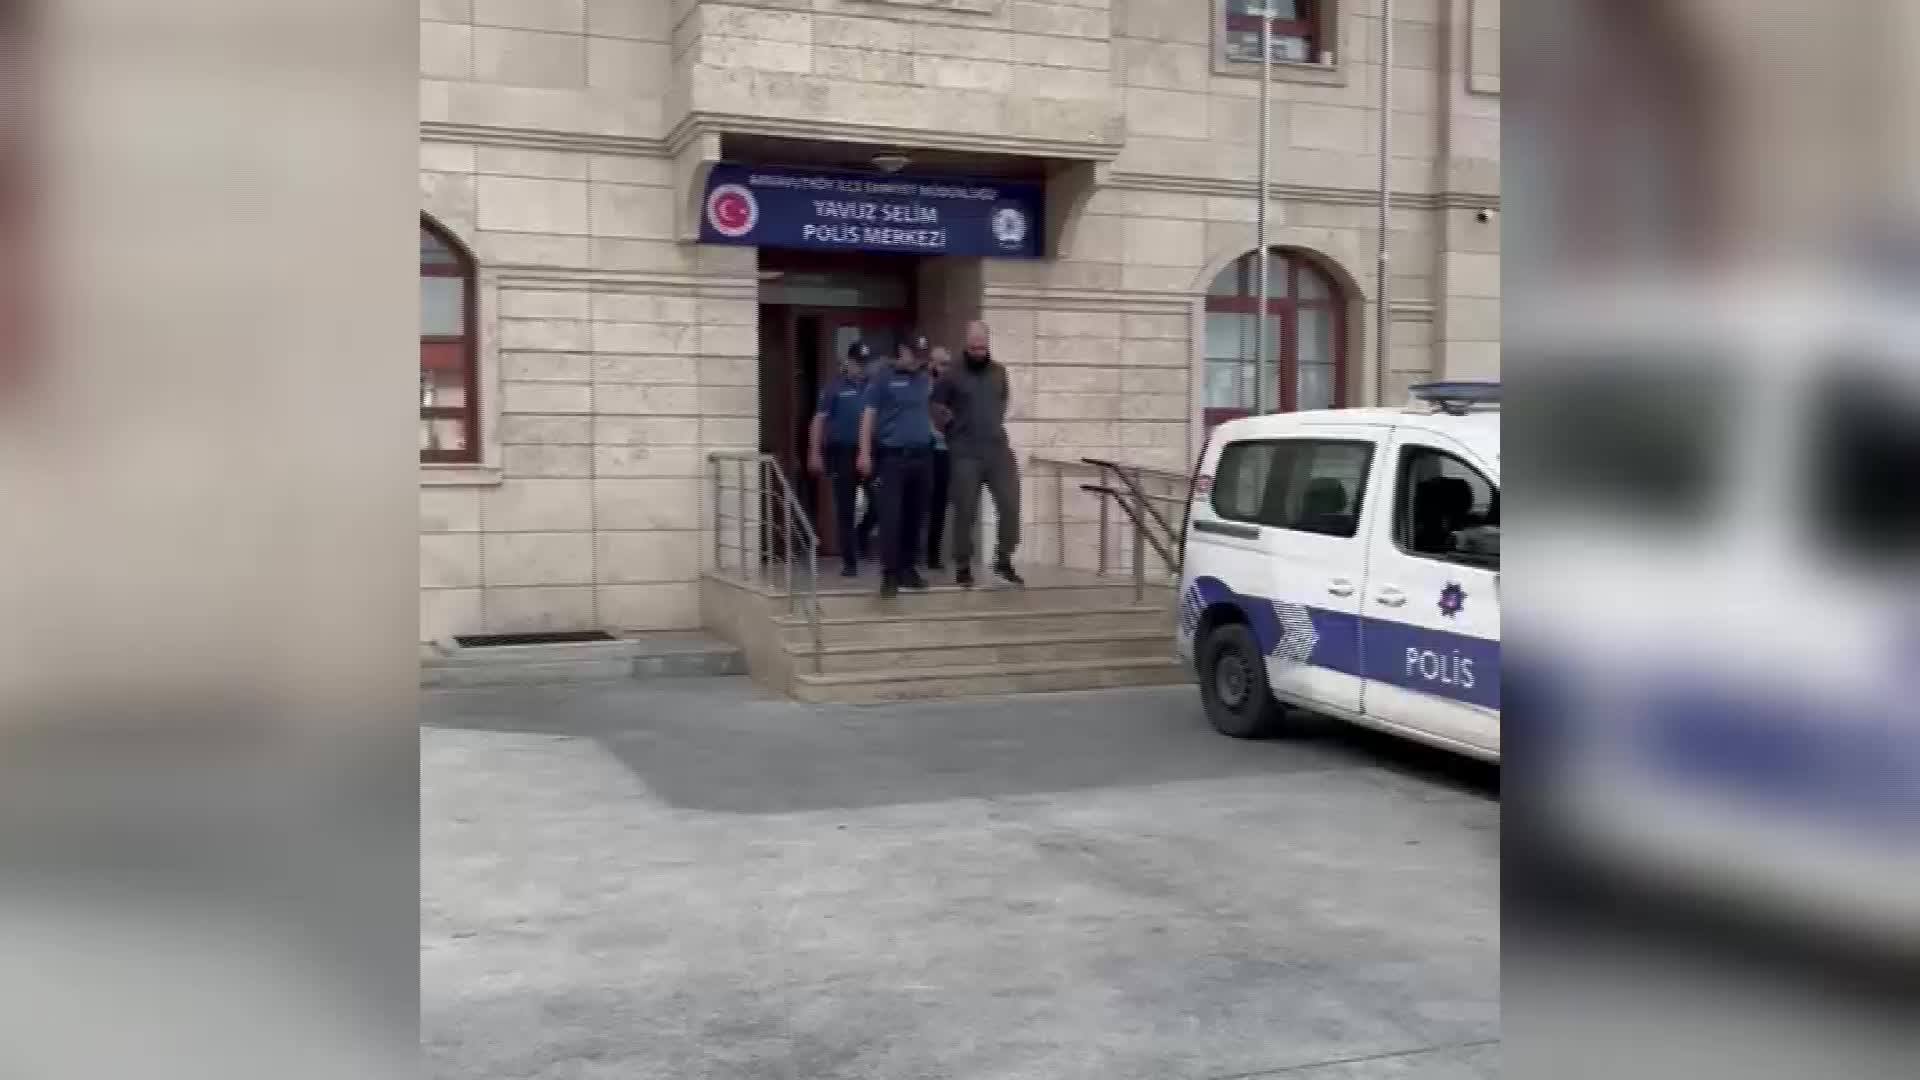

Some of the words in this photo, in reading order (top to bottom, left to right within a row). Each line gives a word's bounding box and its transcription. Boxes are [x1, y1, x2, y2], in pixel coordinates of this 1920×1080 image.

[812, 200, 876, 221] YAVUZ
[880, 203, 938, 224] SELİM
[802, 223, 861, 244] POLİS
[863, 227, 946, 248] MERKEZİ
[1405, 646, 1476, 689] POLİS
